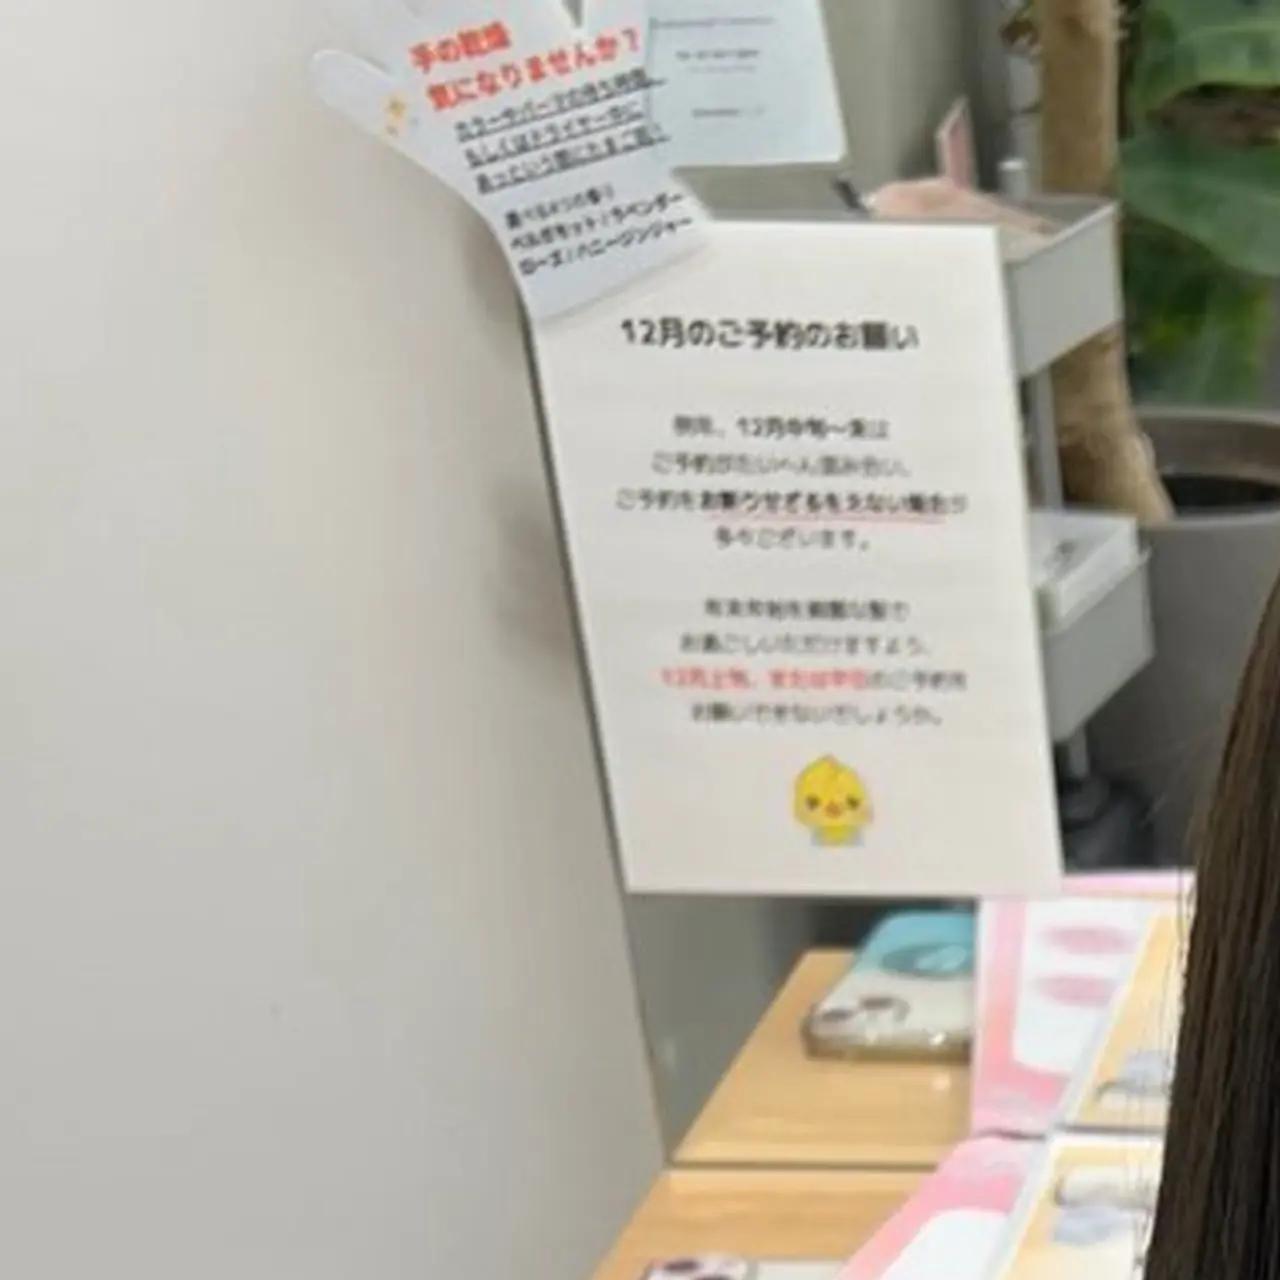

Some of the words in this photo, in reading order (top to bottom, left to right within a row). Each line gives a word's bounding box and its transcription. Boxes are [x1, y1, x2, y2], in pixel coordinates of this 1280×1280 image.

[620, 317, 920, 352] 12月のご予約のお願い
